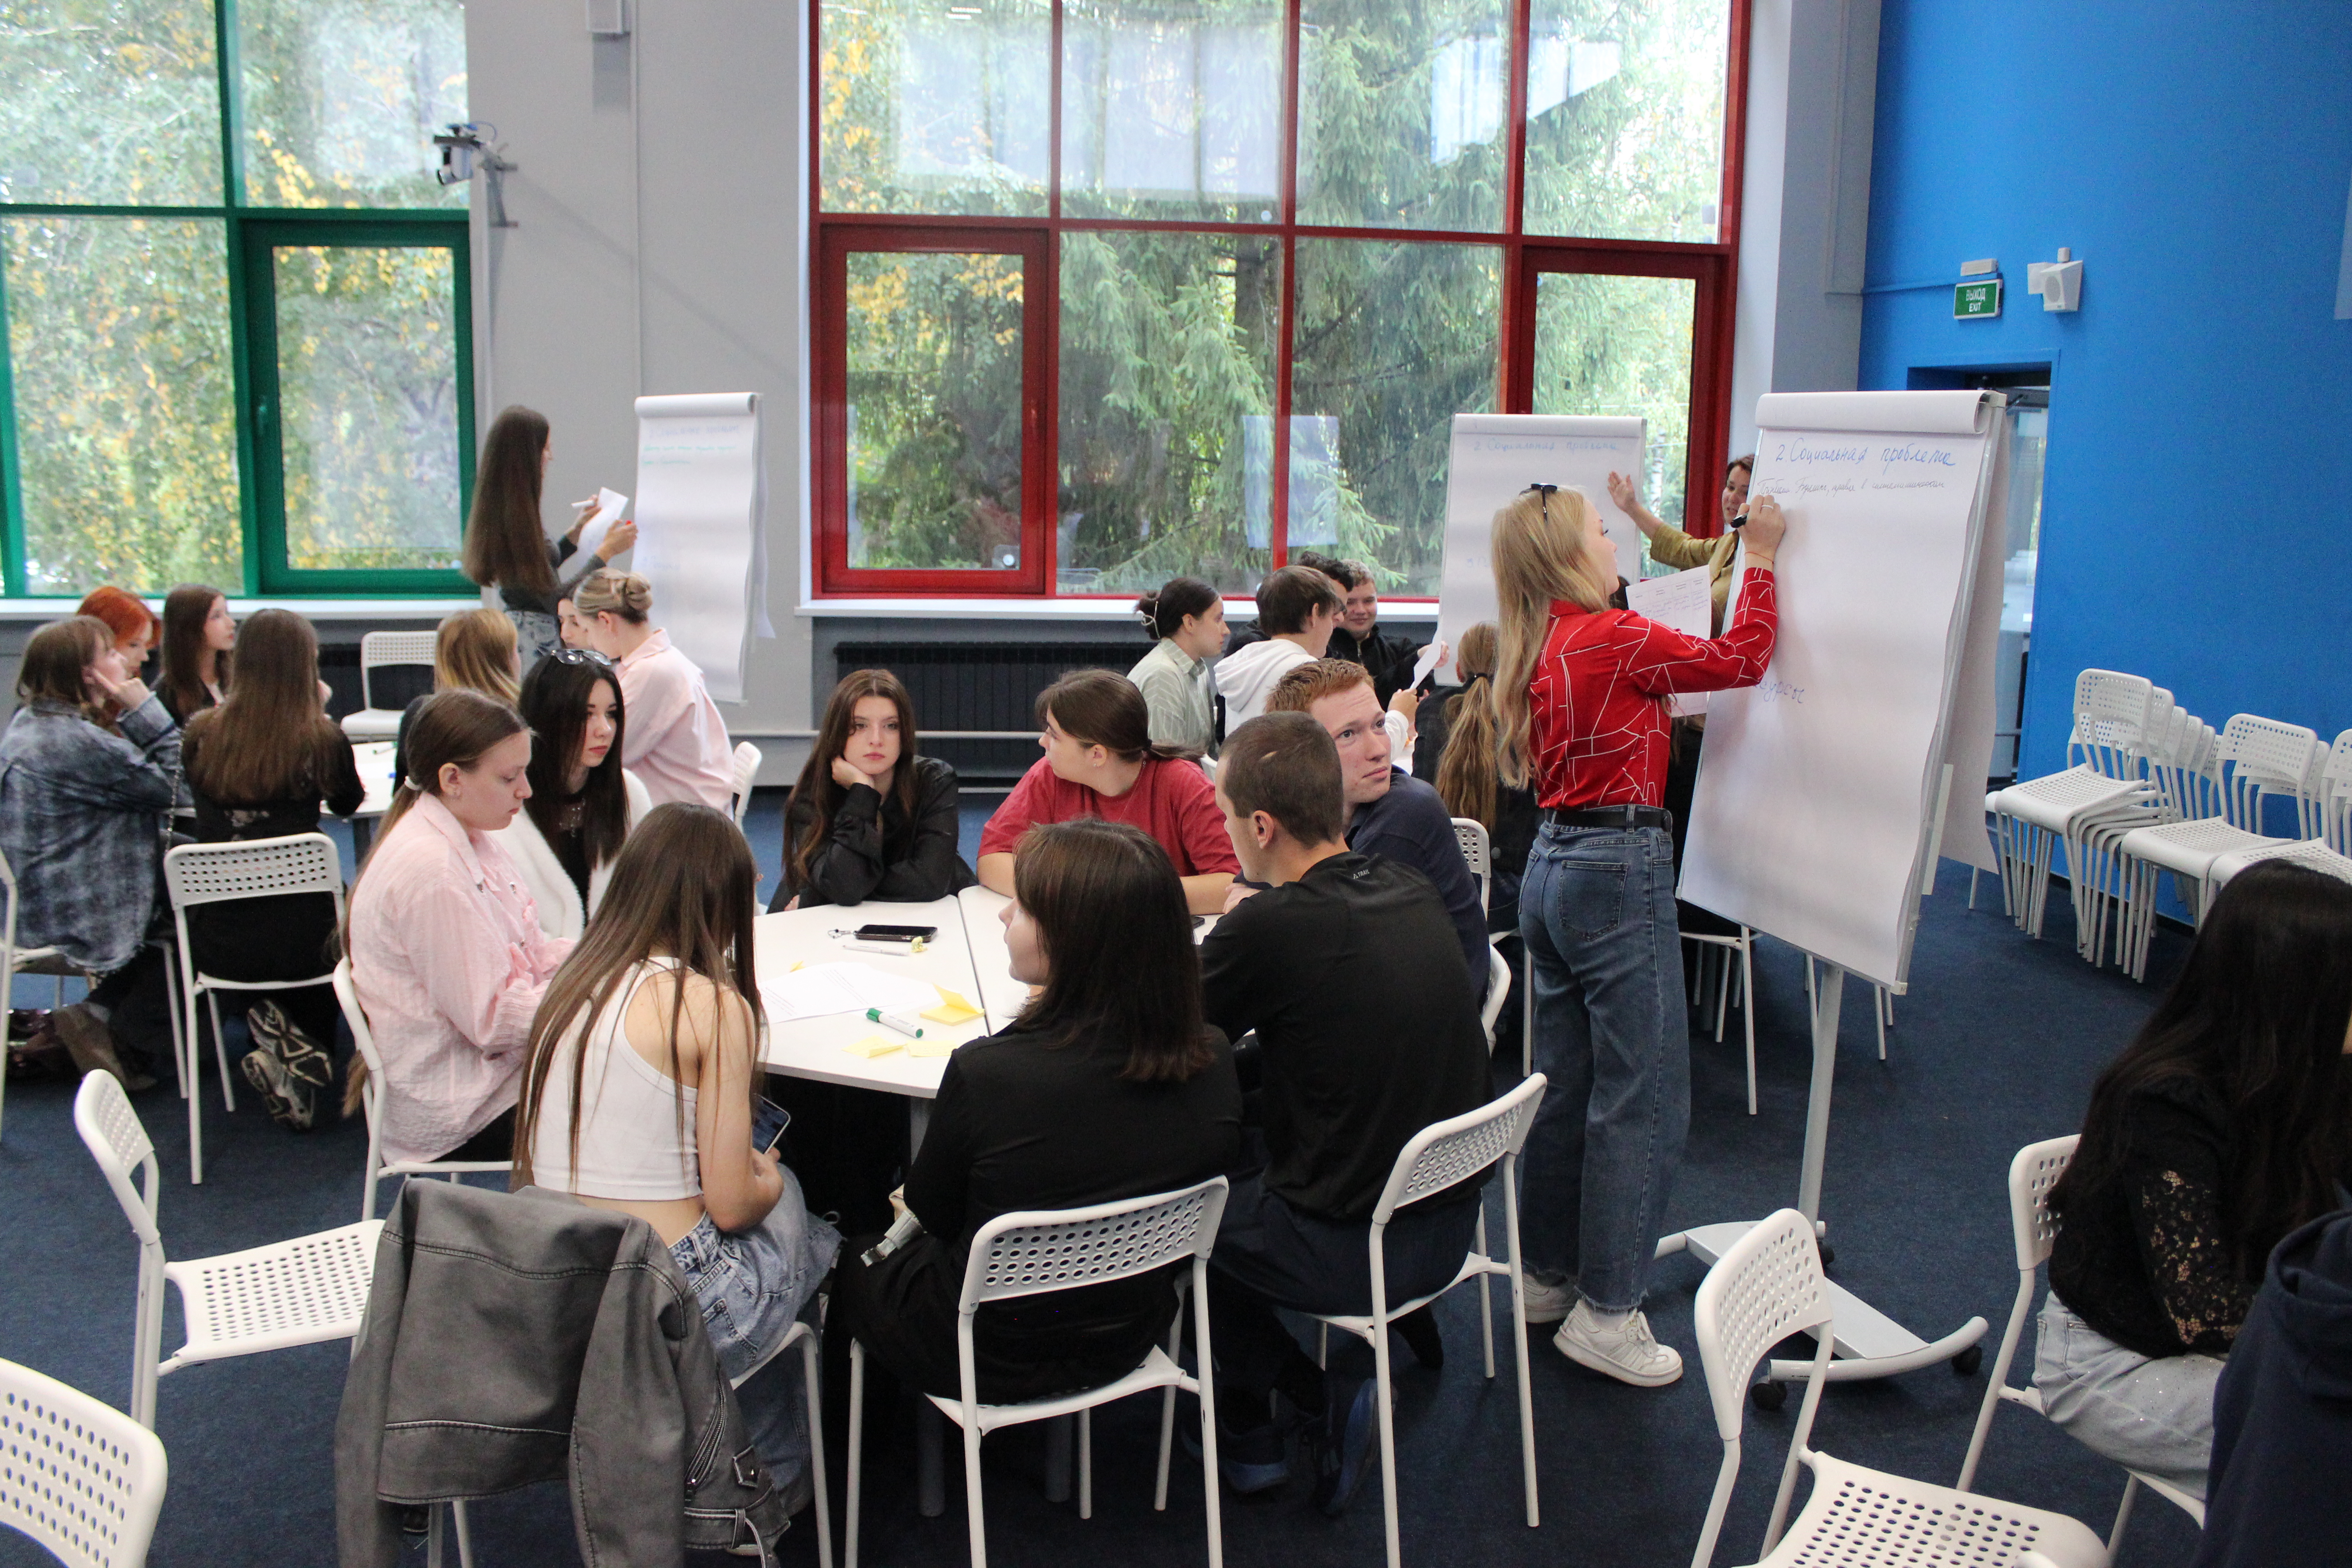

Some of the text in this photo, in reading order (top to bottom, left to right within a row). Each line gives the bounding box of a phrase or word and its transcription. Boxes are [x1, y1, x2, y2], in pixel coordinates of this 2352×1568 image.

[1966, 288, 1986, 301] ВЫХОД
[1969, 302, 1982, 312] EXIT
[1790, 437, 1868, 464] Социальная
[1881, 443, 1956, 476] проблема
